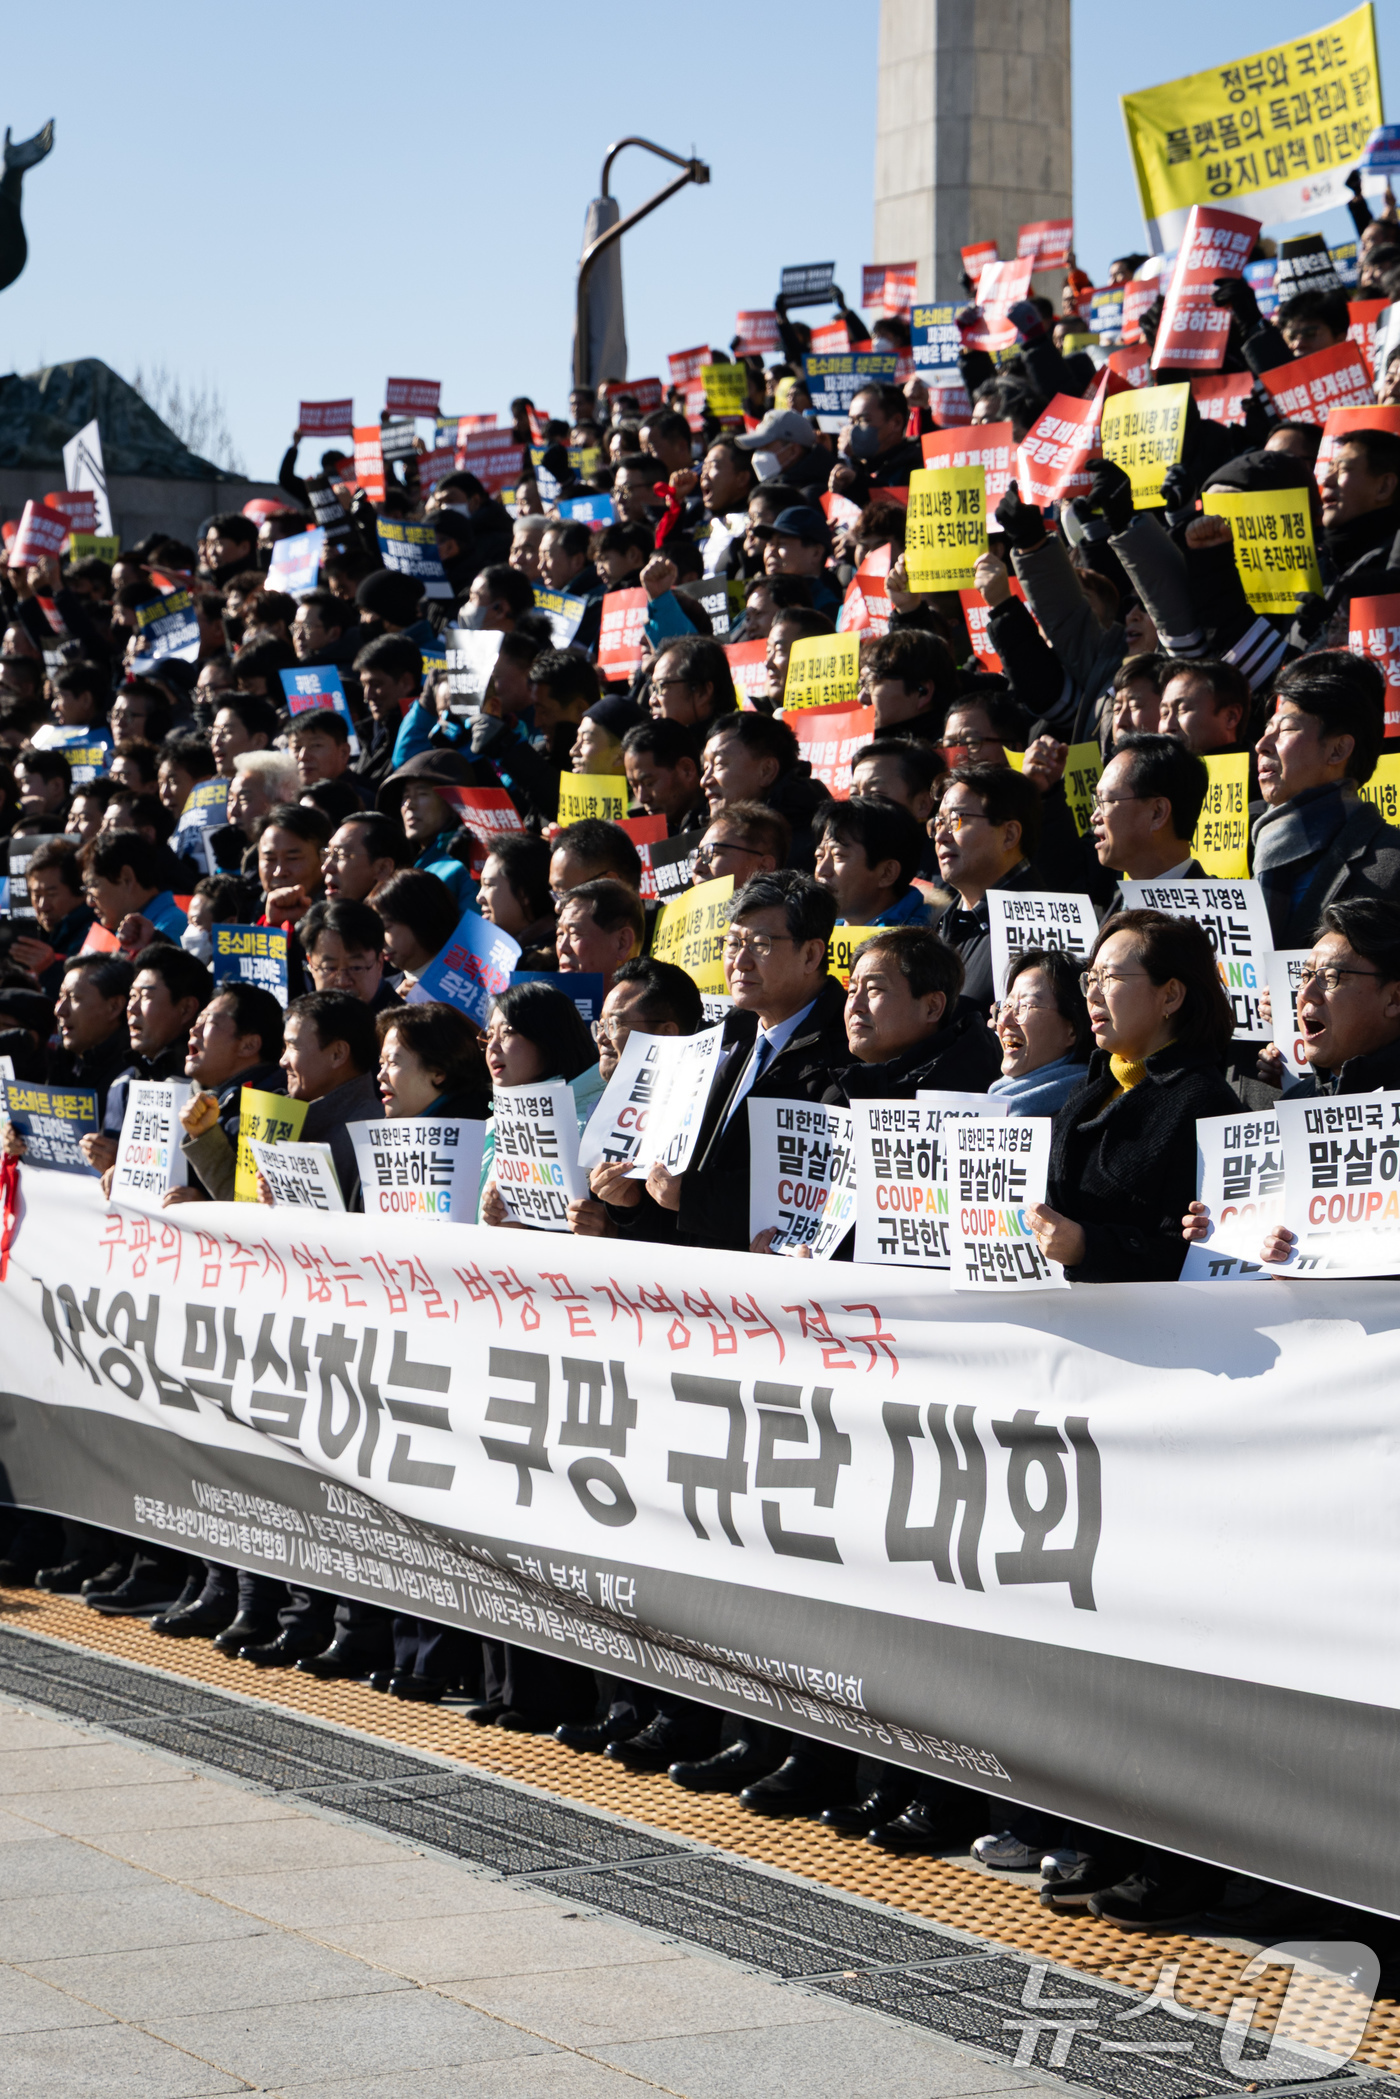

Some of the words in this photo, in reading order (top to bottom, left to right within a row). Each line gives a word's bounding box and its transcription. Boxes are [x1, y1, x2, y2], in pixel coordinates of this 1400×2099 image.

[1220, 52, 1289, 103] 정부와
[1295, 34, 1348, 76] 국회는
[1166, 106, 1265, 166] 플랫폼의
[1269, 79, 1349, 131] 독과점과
[1206, 154, 1260, 197] 방지
[1265, 136, 1310, 179] 대책
[1192, 227, 1252, 252] 계위협
[1186, 250, 1248, 272] 성하라!
[806, 357, 854, 377] 중소마트
[956, 488, 981, 515] 개정
[937, 521, 984, 549] 추진하라!
[1237, 513, 1277, 541] 제외사항
[1281, 512, 1306, 539] 개정
[1240, 550, 1262, 572] 즉시
[1264, 545, 1314, 572] 추진하라!
[839, 653, 854, 677] 개정
[1069, 767, 1098, 797] 개정
[1226, 781, 1243, 814] 개정
[601, 797, 623, 820] 개정
[1203, 821, 1246, 852] 추진하라!
[1003, 899, 1046, 923] 대한민국
[1049, 901, 1082, 924] 자영업
[1141, 887, 1201, 910] 대한민국
[1202, 888, 1248, 911] 자영업
[674, 907, 704, 943] 제외사항
[217, 931, 268, 956] 중소마트
[238, 956, 281, 983] 파괴하는
[438, 970, 478, 1009] 즉각
[7, 1085, 52, 1115] 중소마트
[52, 1094, 95, 1120] 생존권
[513, 1096, 555, 1118] 자영업
[27, 1113, 77, 1144] 파괴하는
[131, 1110, 170, 1143] 말살하는
[776, 1107, 840, 1139] 대한민국
[868, 1108, 921, 1133] 대한민국
[1304, 1103, 1384, 1135] 대한민국
[368, 1127, 411, 1147] 대한민국
[415, 1126, 460, 1147] 자영업
[958, 1127, 995, 1152] 대한민국
[998, 1128, 1033, 1153] 자영업
[125, 1144, 168, 1168] COUPANG
[287, 1155, 320, 1175] 자영업
[373, 1150, 456, 1187] 말살하는
[495, 1157, 565, 1187] COUPANG
[959, 1157, 1028, 1203] 말살하는
[265, 1169, 330, 1211] 말살하는
[379, 1190, 452, 1214] COUPANG
[777, 1179, 853, 1220] COUPANG
[875, 1183, 949, 1215] COUPAN
[963, 1241, 1052, 1282] 규탄한다!
[99, 1212, 183, 1285] 쿠팡의
[193, 1230, 288, 1300] 멈추지
[290, 1241, 368, 1308] 않는
[359, 1250, 460, 1324] 갑질,
[451, 1260, 542, 1333] 벼랑
[537, 1271, 597, 1338] 끝
[591, 1276, 786, 1366] 자영업의
[780, 1298, 900, 1380] 절규
[180, 1301, 458, 1492] 말살하는
[479, 1345, 639, 1528] 쿠팡
[666, 1371, 853, 1566] 규탄
[882, 1400, 1103, 1612] 대회
[191, 1478, 307, 1534] (사)한국외식업중앙회
[594, 1570, 638, 1620] 계단
[133, 1493, 288, 1564] 한국중소상인자영업자총연합회
[298, 1537, 460, 1612] (사)한국통신판매사업자협회
[470, 1586, 638, 1665] (사)한국휴게음식업중앙회
[886, 1720, 1013, 1783] 을지로위원회
